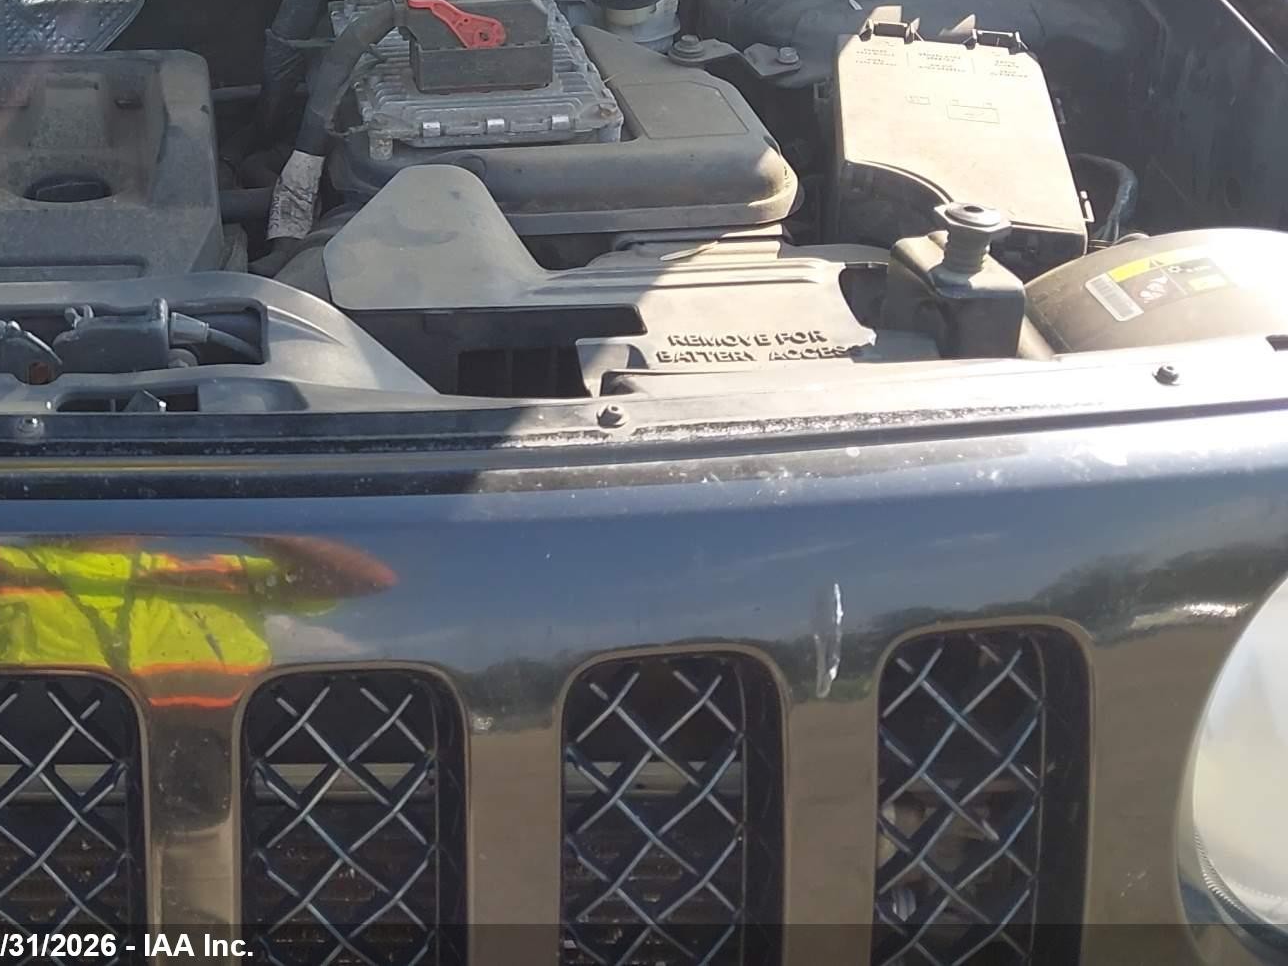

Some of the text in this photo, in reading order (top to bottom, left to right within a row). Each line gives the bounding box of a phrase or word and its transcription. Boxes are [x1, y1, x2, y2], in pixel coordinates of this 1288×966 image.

[667, 330, 828, 347] REMOVE FOR
[655, 350, 758, 363] BATTERY
